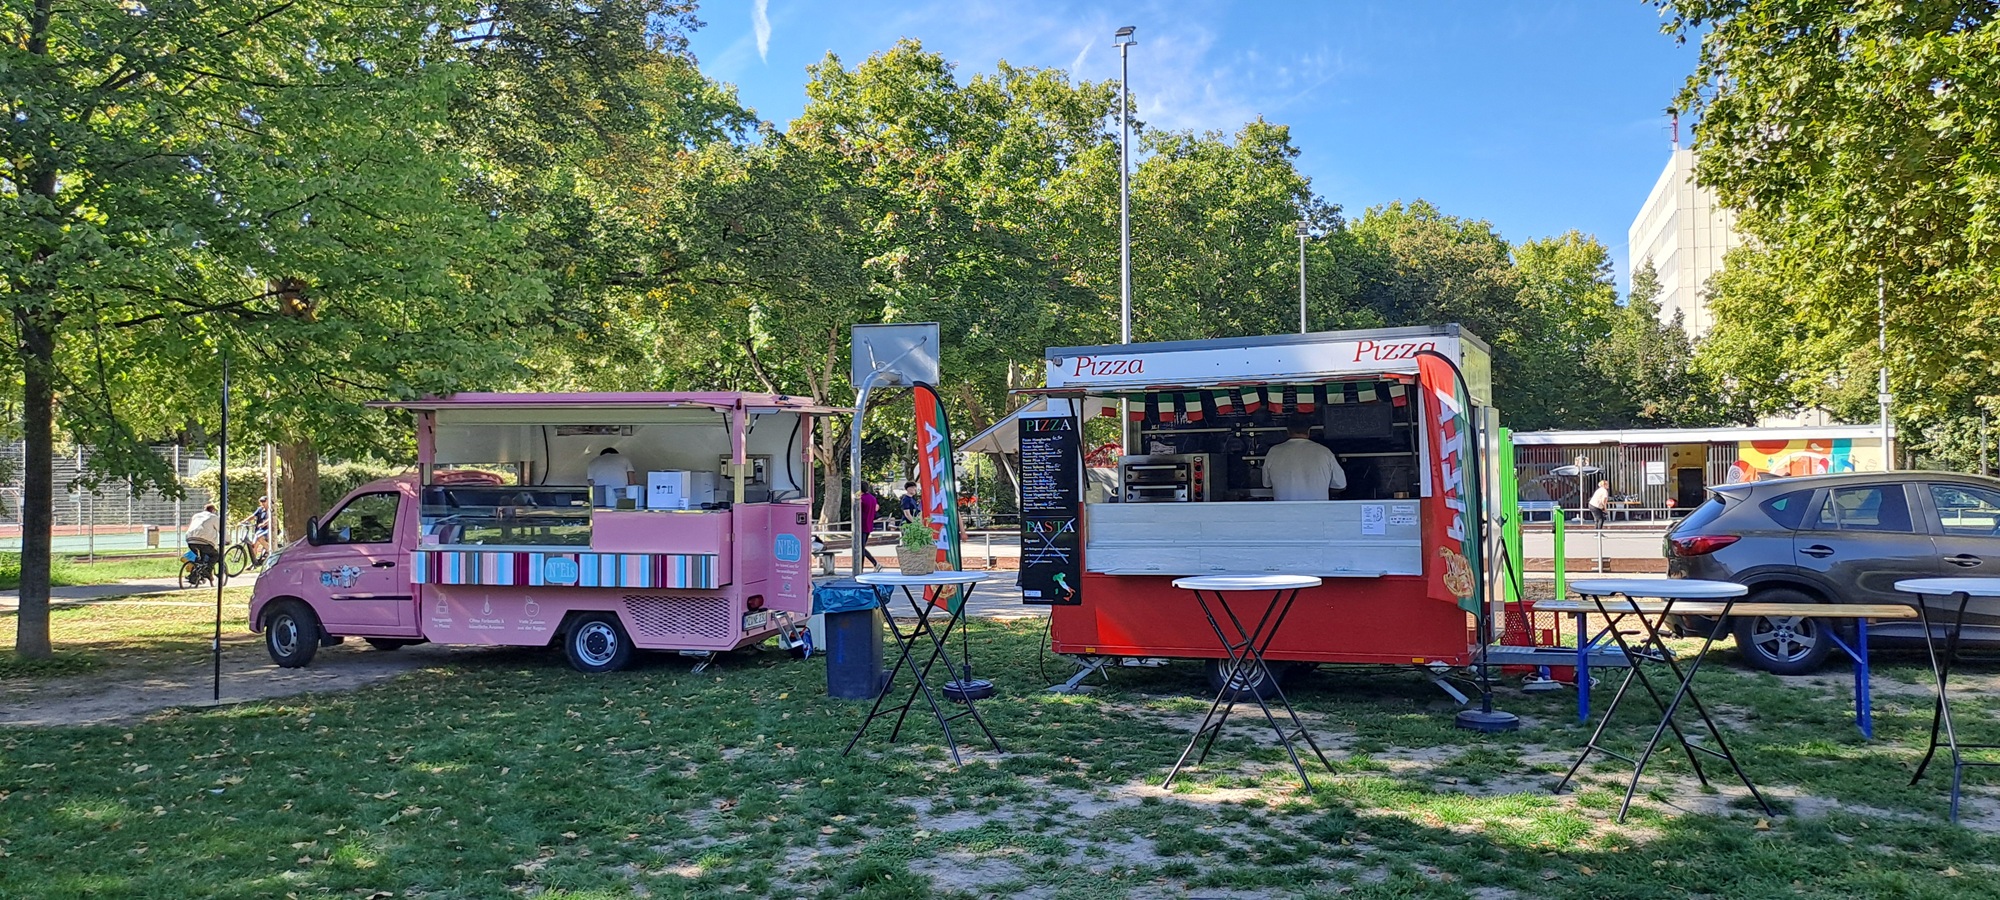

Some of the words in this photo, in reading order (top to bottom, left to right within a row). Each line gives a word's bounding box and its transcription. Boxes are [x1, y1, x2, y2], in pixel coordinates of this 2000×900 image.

[1351, 339, 1435, 362] Pizza
[1073, 355, 1144, 377] Pizza
[1025, 418, 1072, 432] PIZZA
[1025, 520, 1076, 533] PASTA
